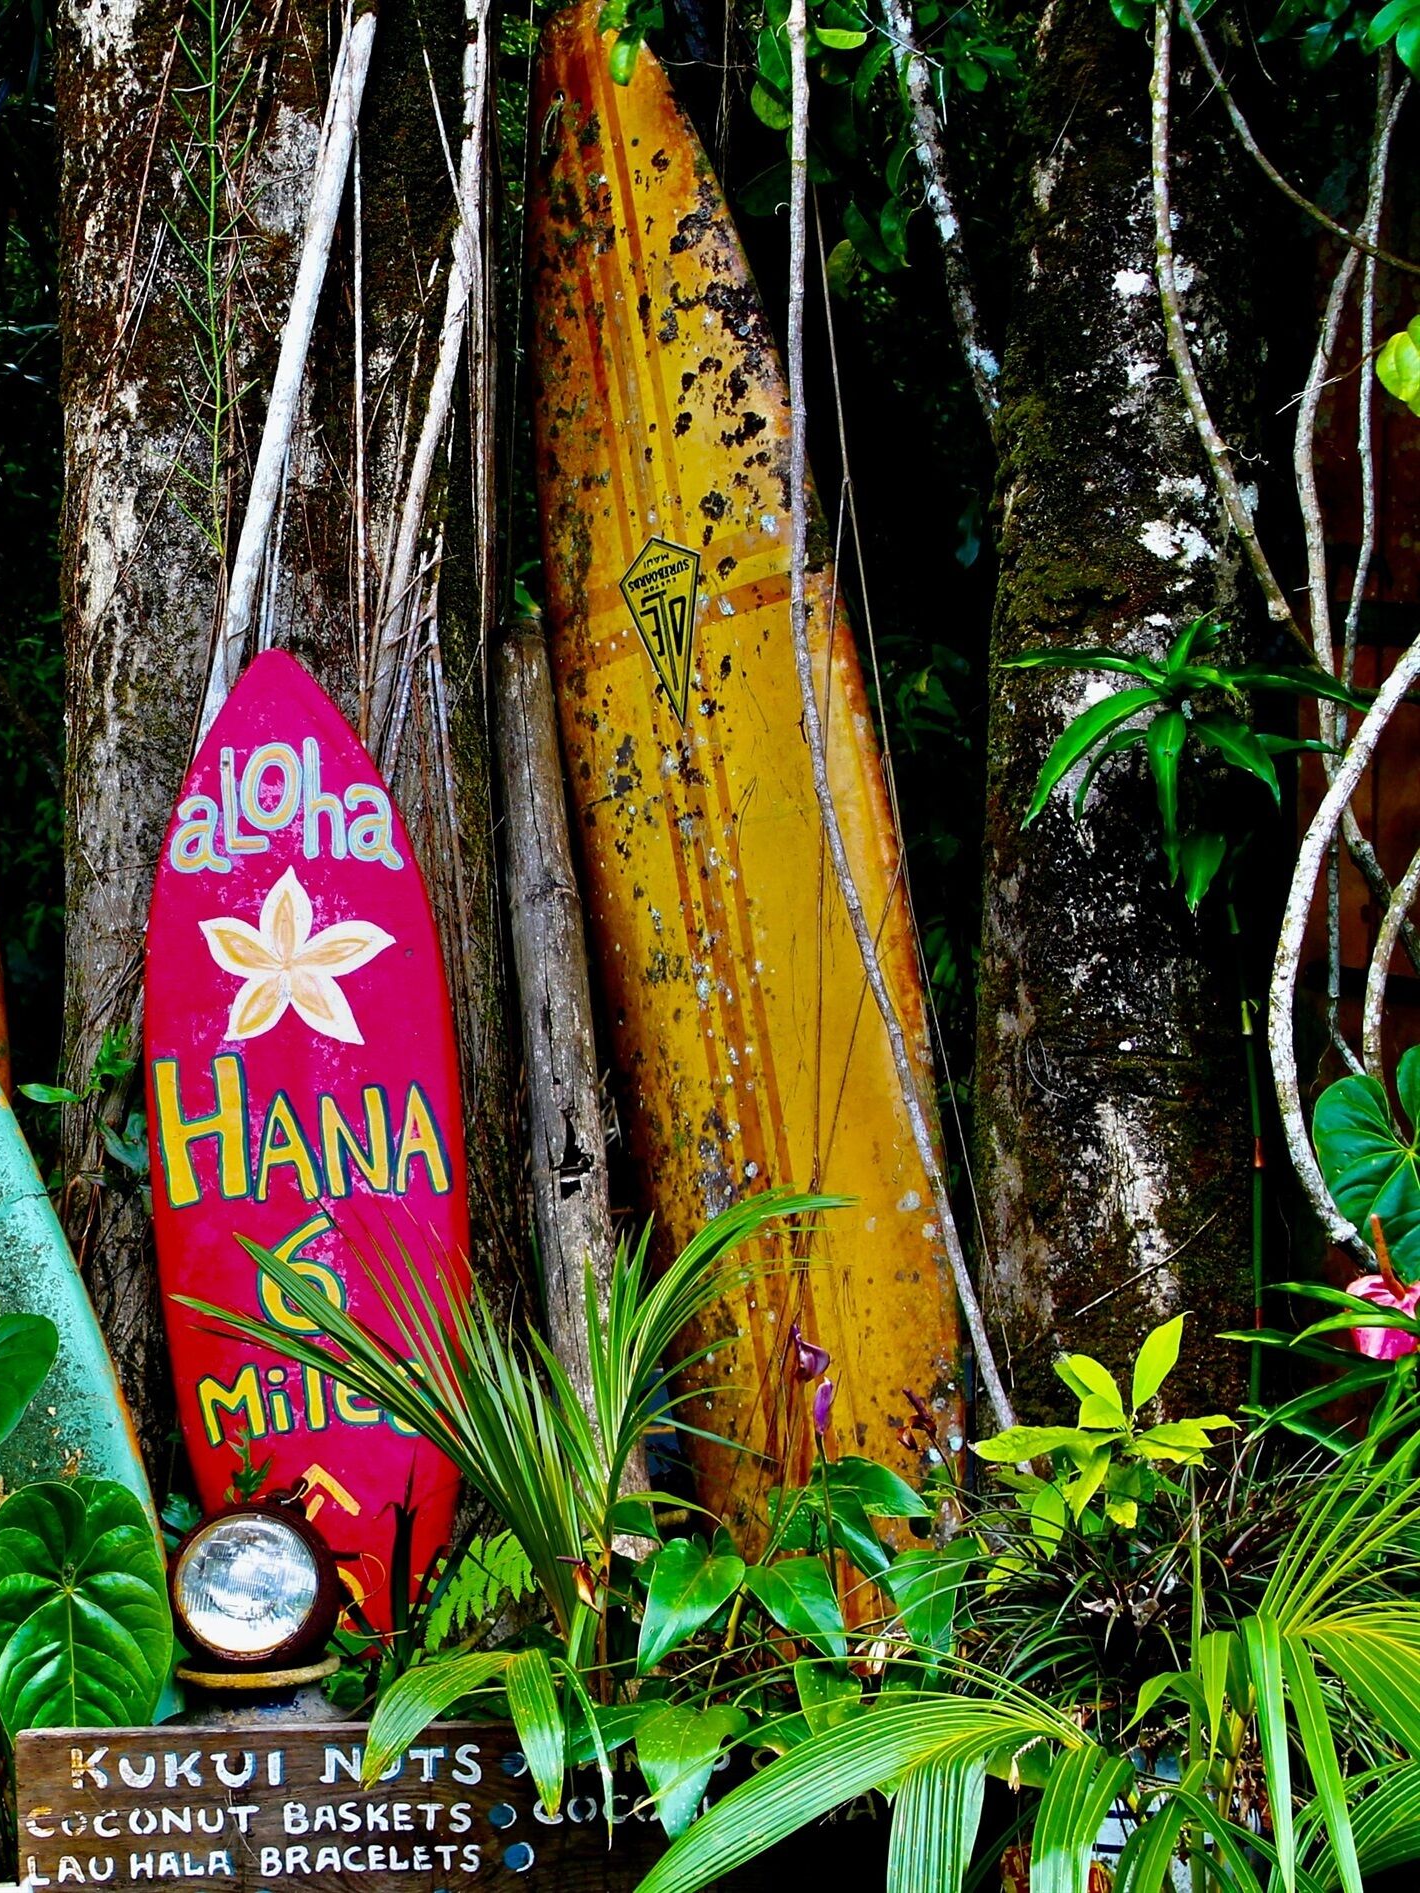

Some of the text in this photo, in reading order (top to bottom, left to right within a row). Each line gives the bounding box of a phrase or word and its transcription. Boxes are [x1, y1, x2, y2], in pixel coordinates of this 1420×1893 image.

[628, 558, 690, 592] SURFBOARDS
[643, 552, 670, 569] MAUI
[152, 1052, 451, 1206] HANA
[256, 1214, 347, 1337] 6
[70, 1746, 280, 1789] KUKUI
[26, 1800, 473, 1838] COCONUT BASKETS
[29, 1844, 480, 1887] LAU HALA BRACELETS
